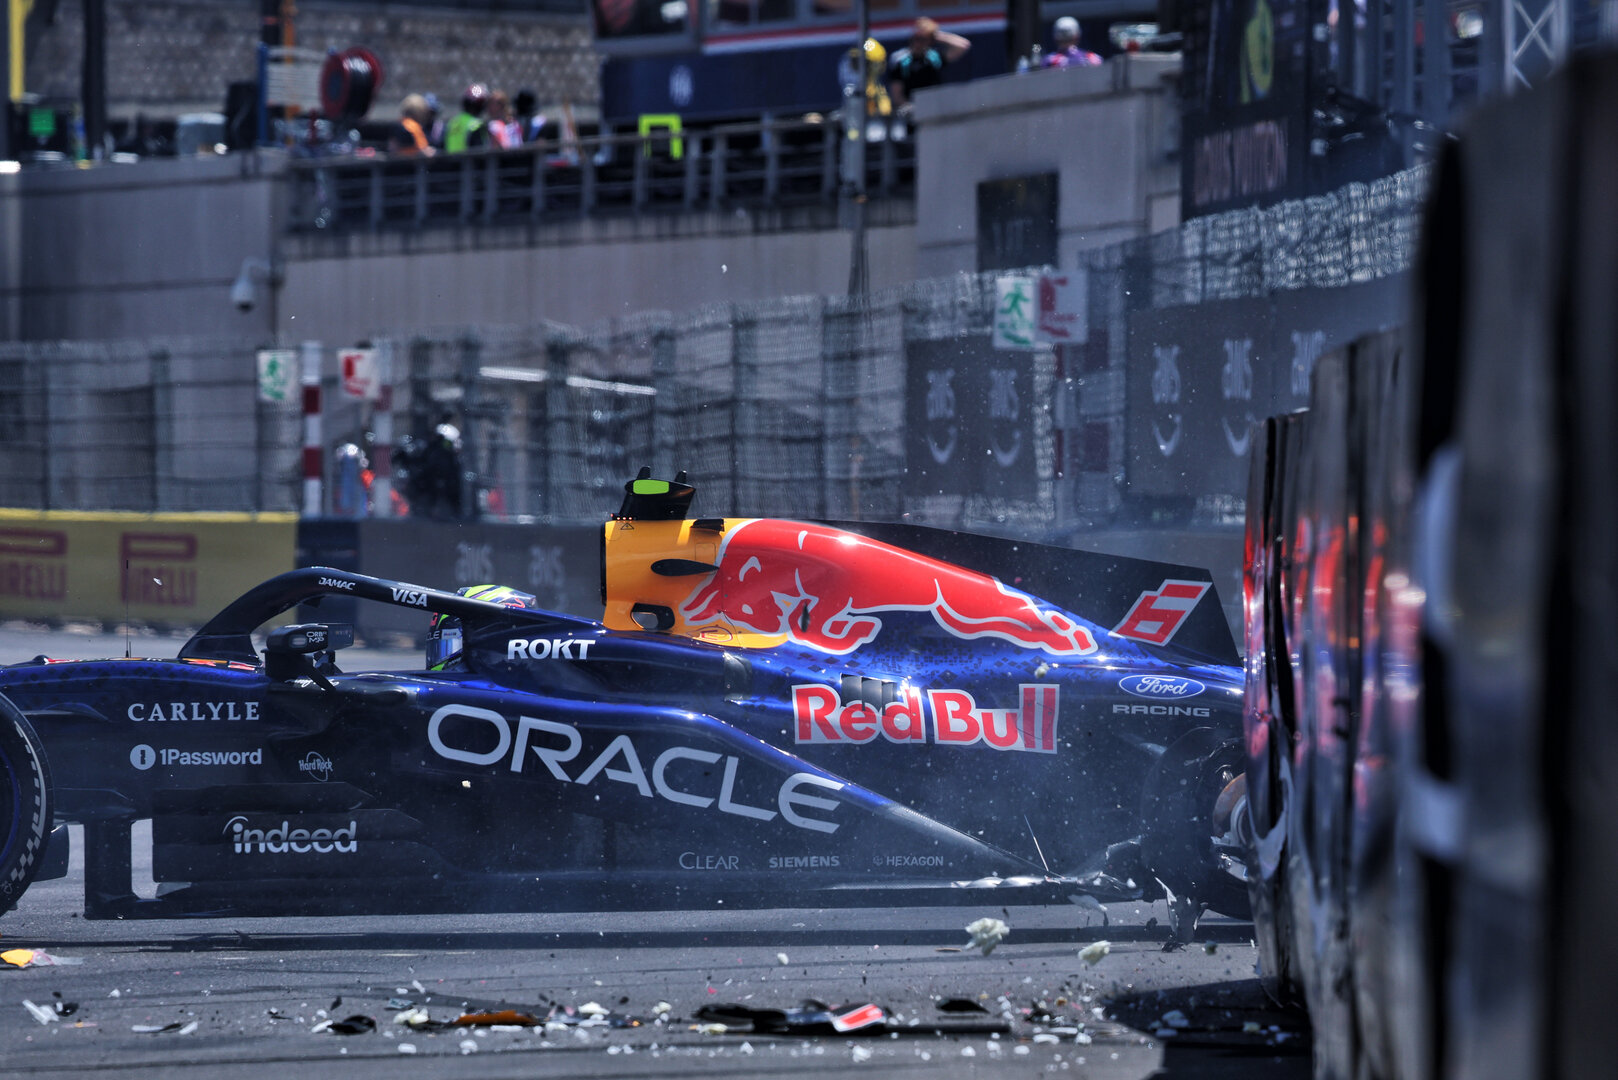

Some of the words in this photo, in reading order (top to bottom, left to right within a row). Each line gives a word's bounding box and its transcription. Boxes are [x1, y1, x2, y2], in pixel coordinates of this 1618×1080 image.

[319, 577, 355, 590] DAMAC
[390, 587, 428, 607] VISA
[1109, 579, 1212, 646] 6
[507, 638, 596, 660] ROKT
[1136, 676, 1188, 695] Ford
[127, 702, 260, 721] CARLYLE
[793, 685, 926, 744] Red
[928, 684, 1060, 753] Bull
[1112, 704, 1210, 717] RACING
[160, 748, 263, 765] 1Password
[298, 758, 316, 771] Hard
[316, 757, 334, 773] Rock
[427, 703, 844, 834] ORACLE
[232, 819, 357, 853] indeed
[678, 851, 739, 870] CLEAR
[768, 855, 840, 869] SIEMENS
[885, 855, 944, 867] HEXAGON
